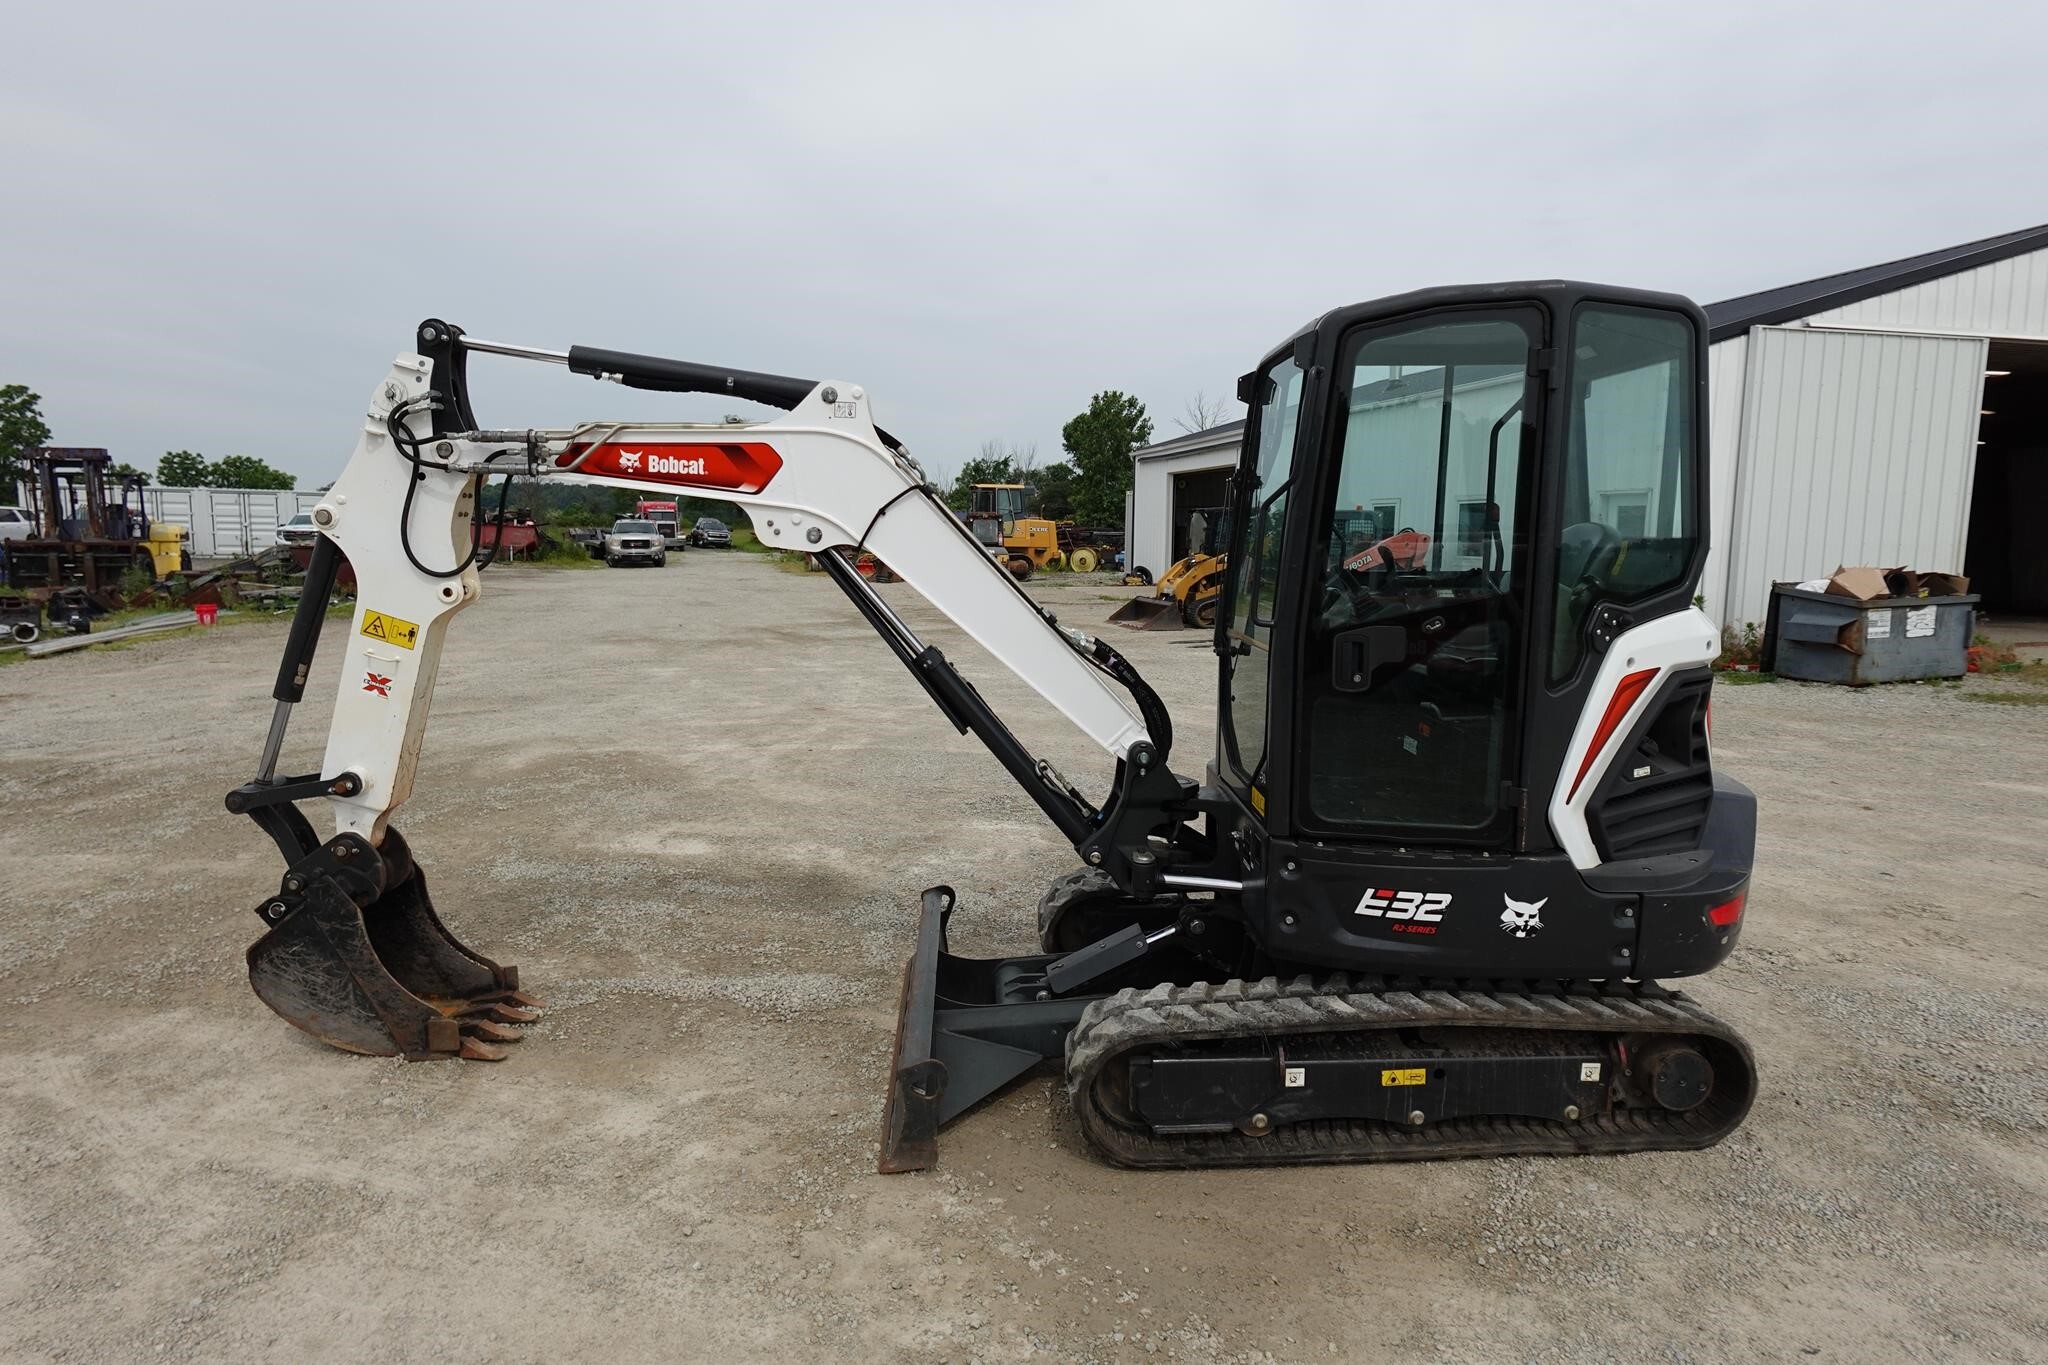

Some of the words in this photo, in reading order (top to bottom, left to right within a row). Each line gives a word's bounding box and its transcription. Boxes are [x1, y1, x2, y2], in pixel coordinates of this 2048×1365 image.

[648, 455, 705, 475] Bobcat
[1354, 887, 1453, 922] E32
[1392, 924, 1437, 935] R2-SERIES
